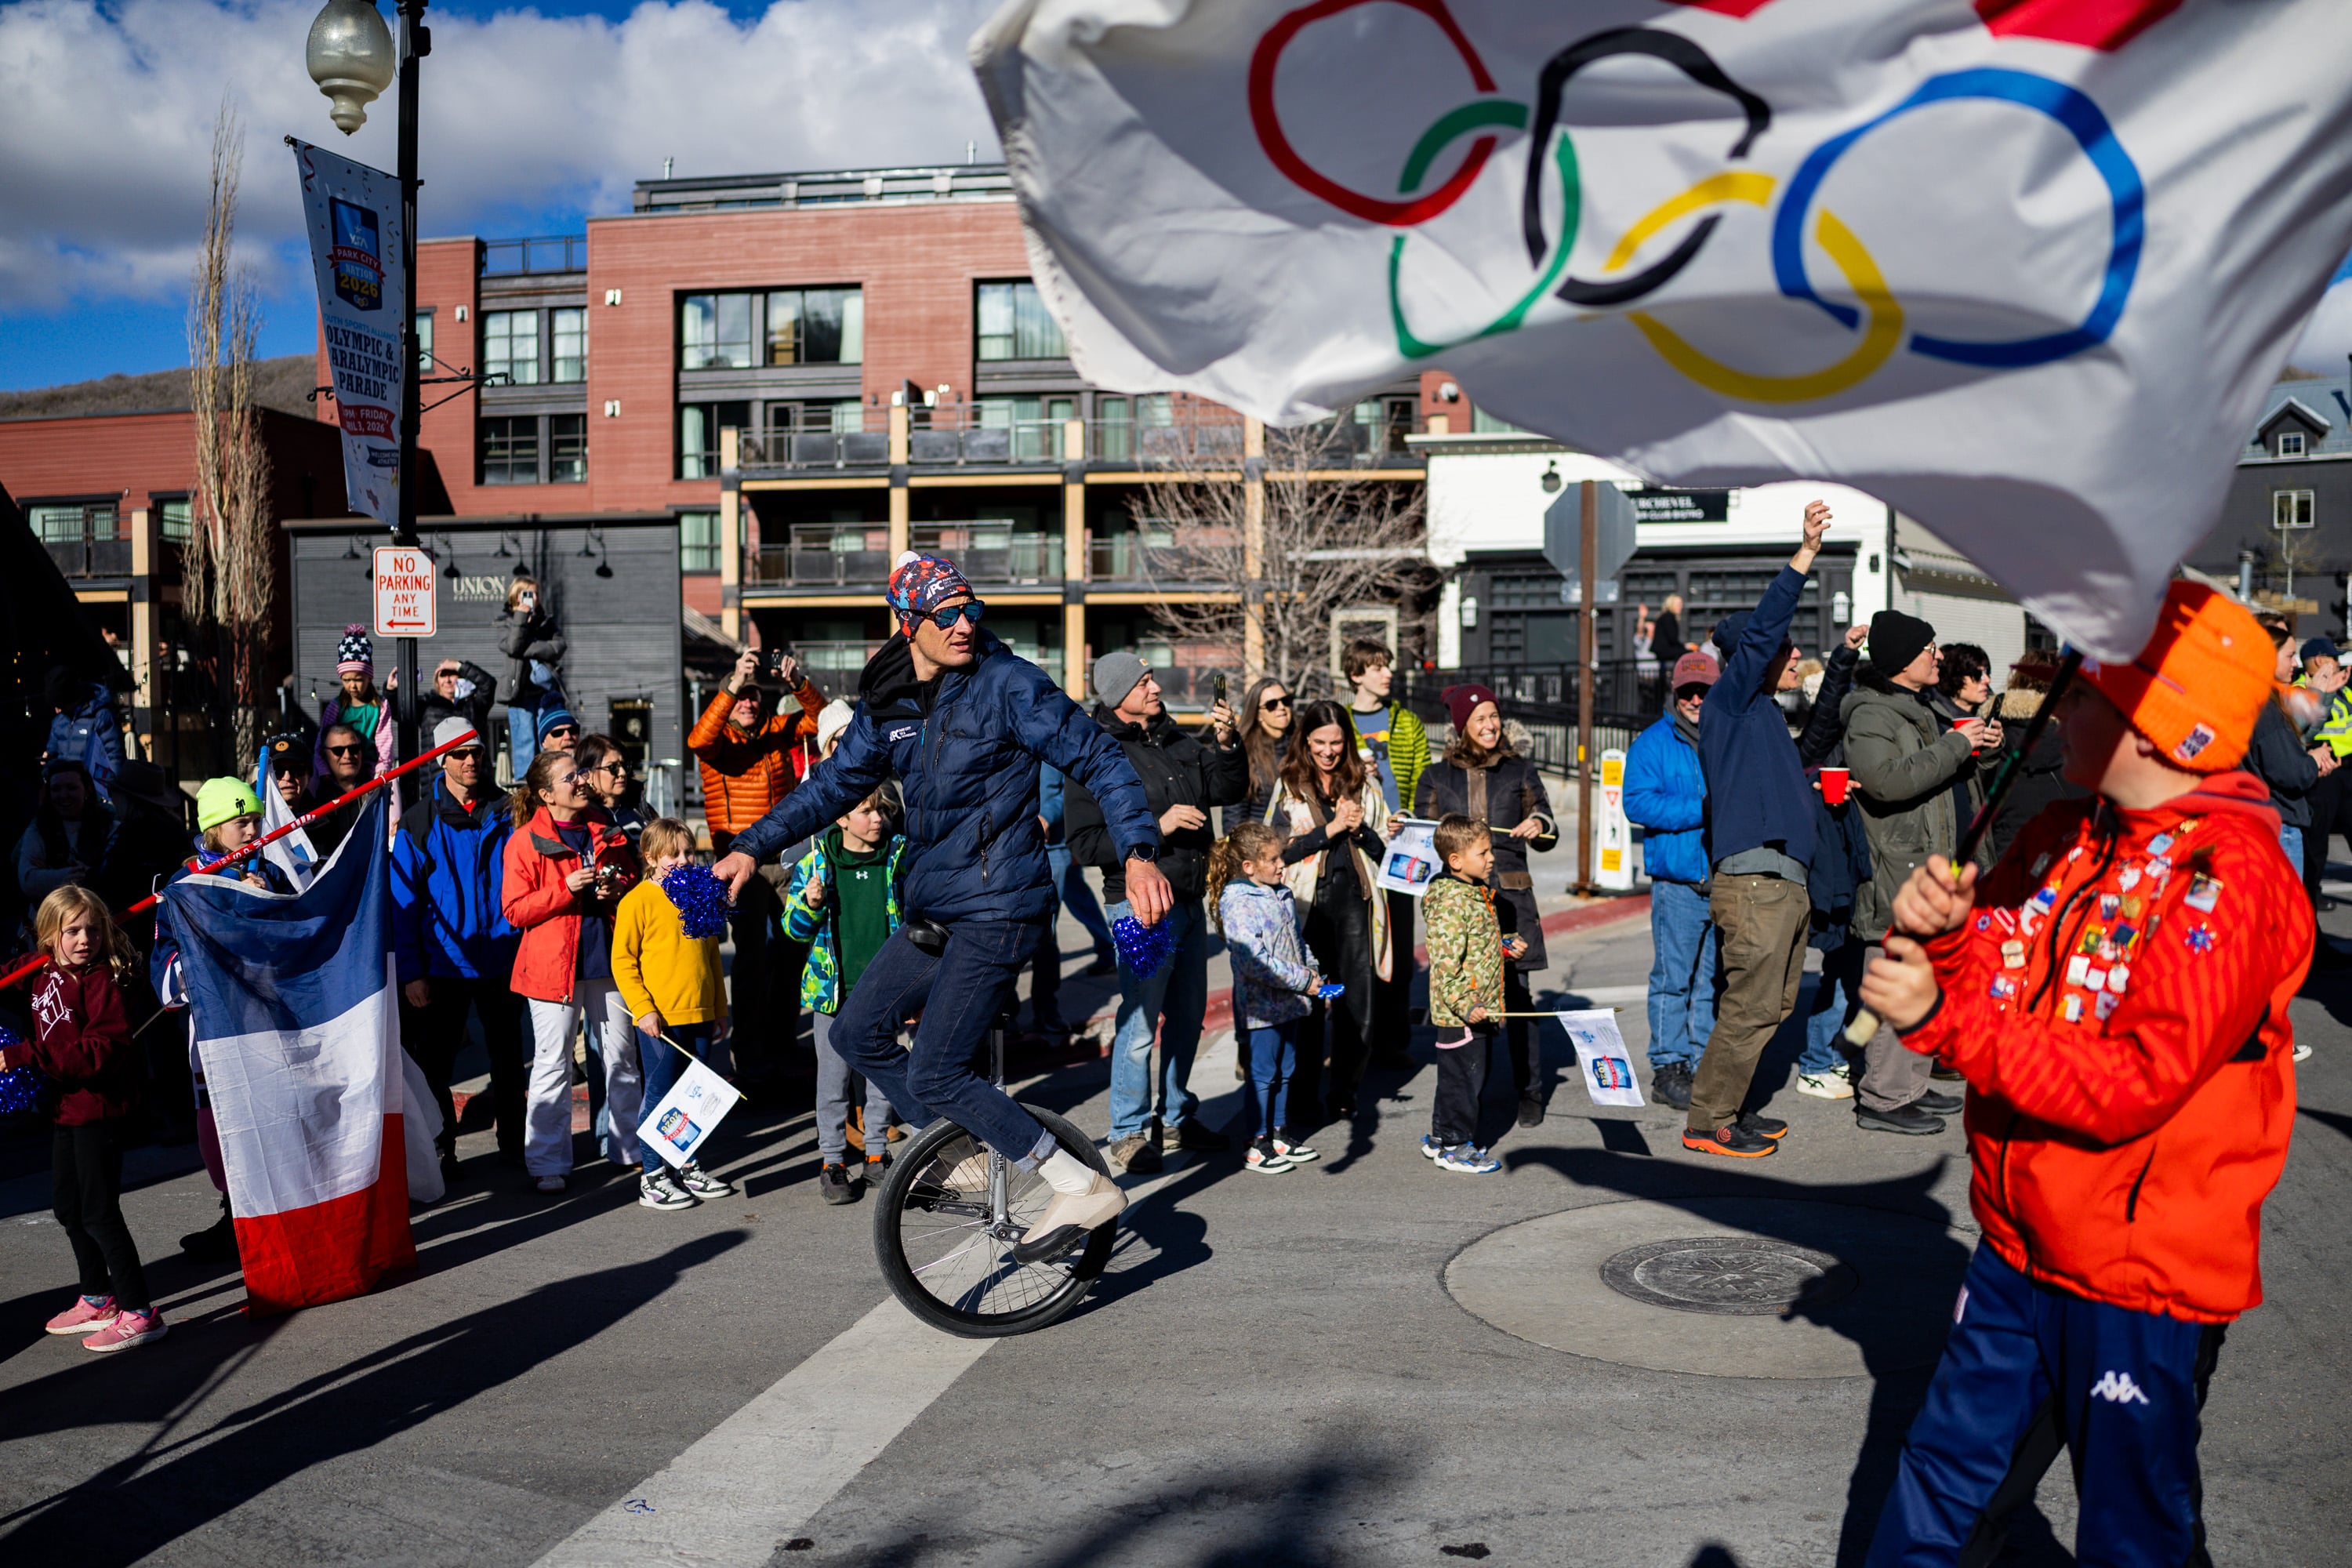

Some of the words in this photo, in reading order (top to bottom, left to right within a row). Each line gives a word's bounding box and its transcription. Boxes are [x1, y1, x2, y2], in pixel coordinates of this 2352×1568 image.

[337, 249, 359, 260] PARK
[361, 253, 379, 268] CITY
[345, 263, 373, 280] NATION
[339, 273, 379, 298] 2026
[326, 324, 383, 358] OLYMPIC
[386, 343, 394, 361] &
[332, 347, 398, 383] ARALYMPIC
[338, 371, 387, 401] PARADE
[343, 408, 355, 419] PM
[360, 409, 389, 424] FRIDAY,
[367, 422, 385, 433] 2026
[394, 557, 416, 573] NO
[379, 575, 430, 591] PARKING
[452, 575, 506, 596] UNION
[394, 593, 416, 604] ANY
[391, 606, 419, 617] TIME
[1596, 1061, 1607, 1086] 2026
[661, 1111, 680, 1131] 2026
